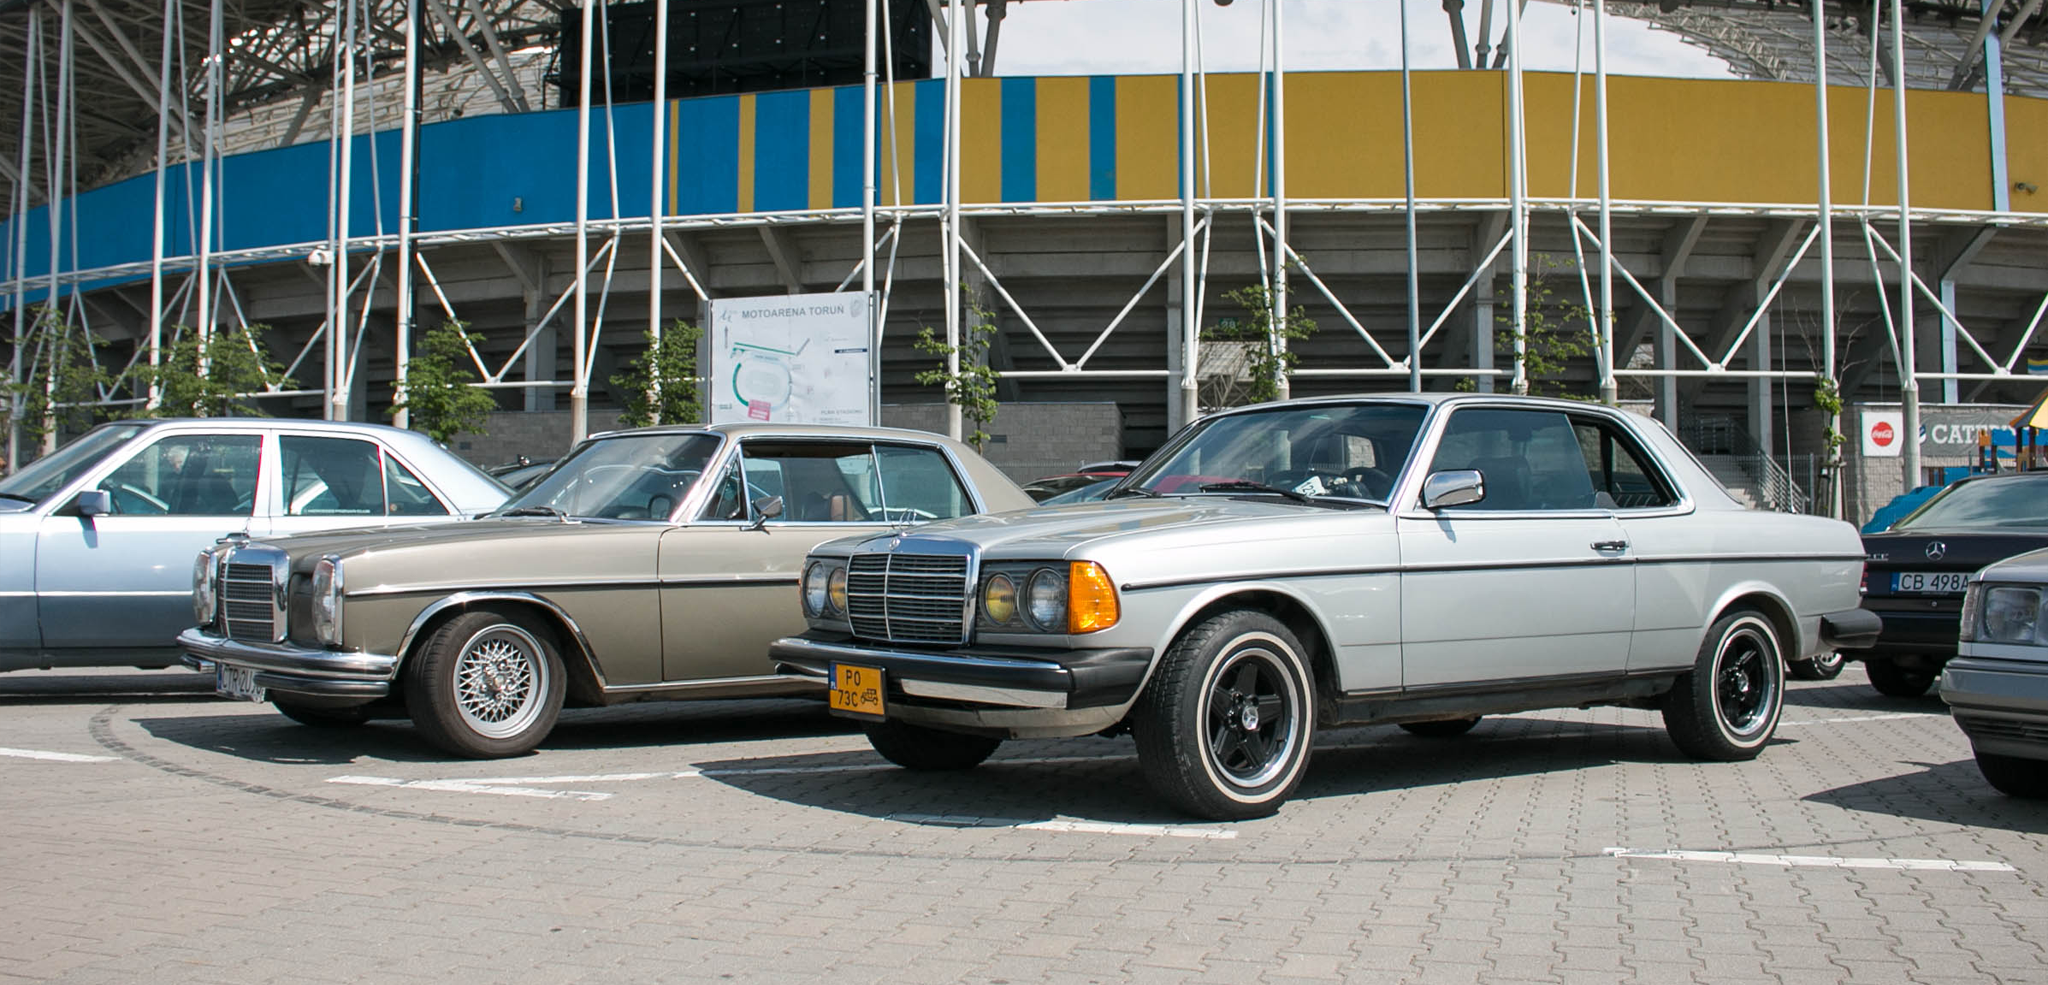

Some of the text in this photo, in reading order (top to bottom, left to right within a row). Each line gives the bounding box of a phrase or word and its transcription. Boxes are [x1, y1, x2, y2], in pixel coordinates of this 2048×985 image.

[742, 308, 806, 319] MOTOARENA
[809, 305, 845, 316] TORUŃ
[1901, 574, 1924, 590] CB
[845, 669, 861, 687] PO
[838, 689, 858, 707] 73C
